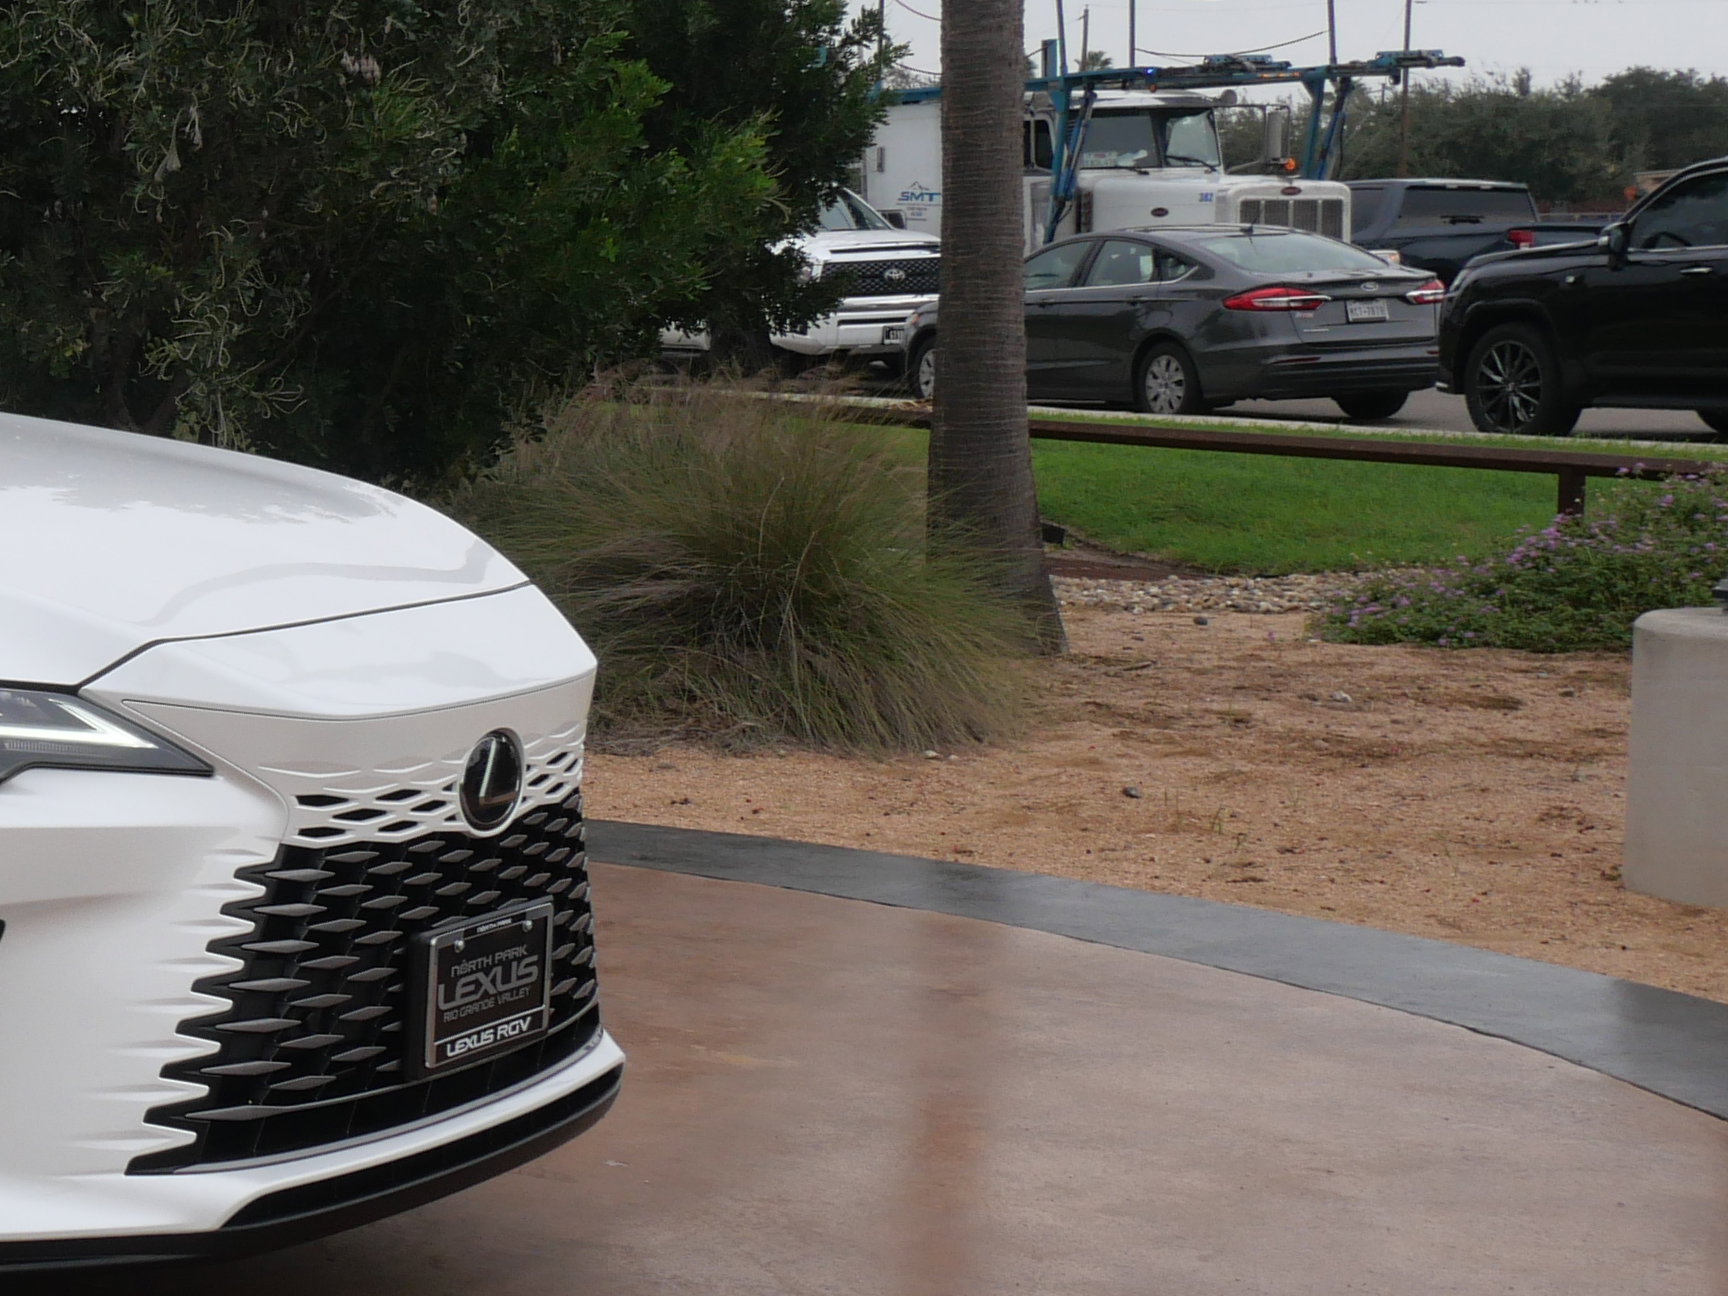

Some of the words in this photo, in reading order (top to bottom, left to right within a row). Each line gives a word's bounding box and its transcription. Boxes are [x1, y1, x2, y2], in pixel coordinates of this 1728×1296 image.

[897, 191, 942, 202] SMT
[494, 944, 528, 964] PARK
[438, 954, 538, 1011] LEXUS
[443, 1009, 459, 1023] RIO
[459, 996, 495, 1018] GRANDE
[496, 986, 530, 1005] VALLEY
[447, 1028, 495, 1058] LEXUS
[496, 1016, 532, 1041] RGV
